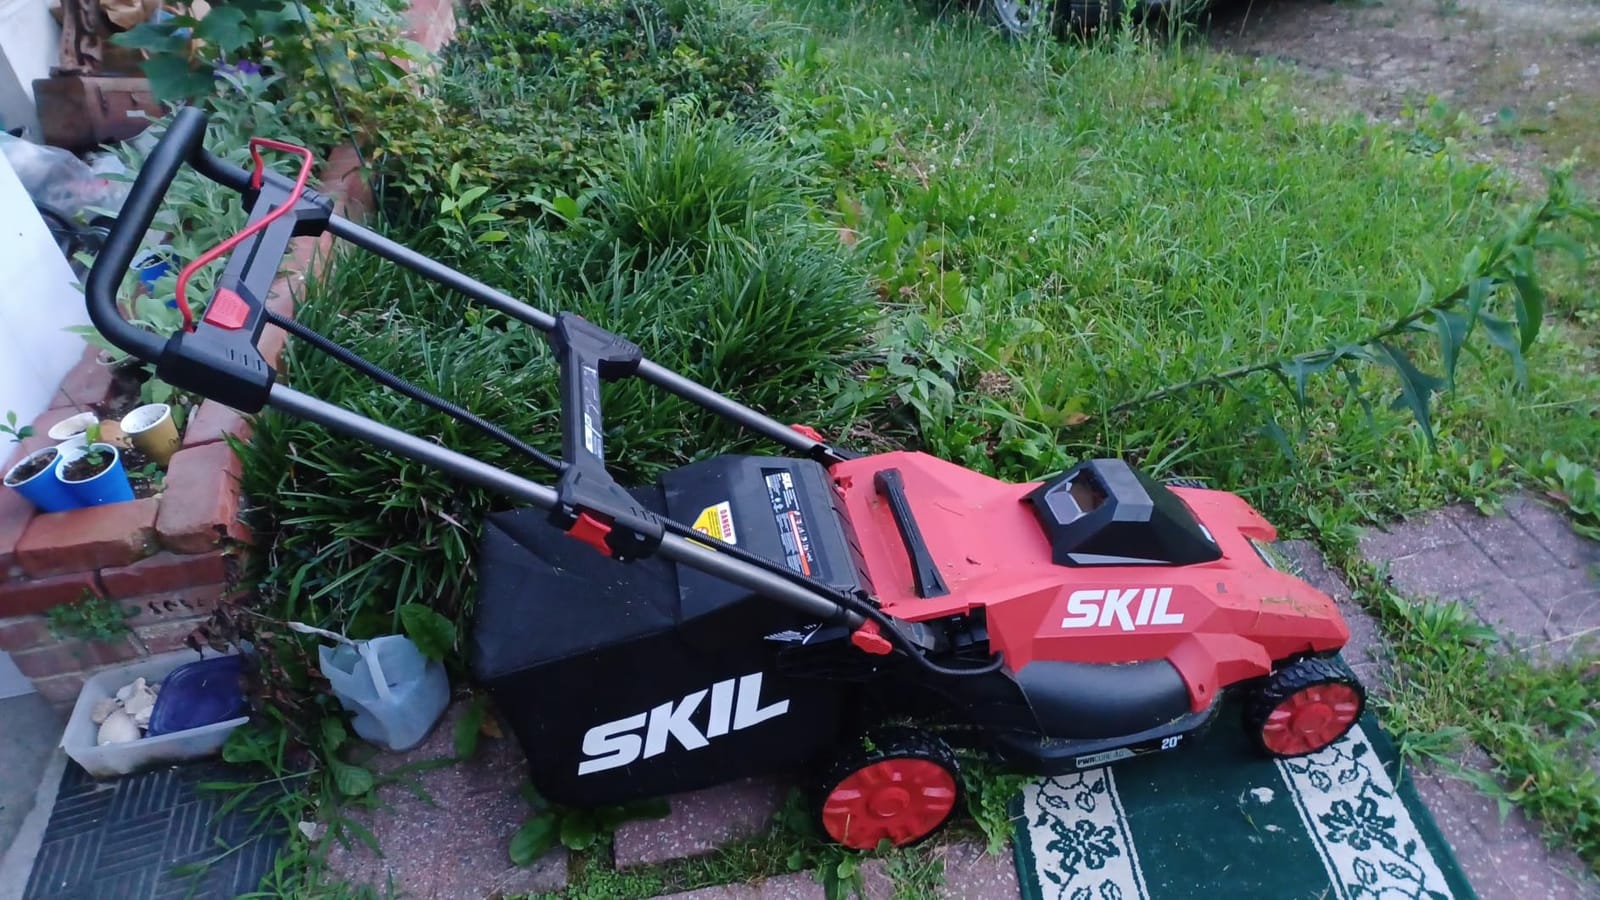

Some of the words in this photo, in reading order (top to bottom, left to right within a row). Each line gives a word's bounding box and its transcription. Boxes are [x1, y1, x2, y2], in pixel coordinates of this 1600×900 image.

[1061, 587, 1184, 631] SKIL
[578, 671, 790, 776] SKIL
[1161, 735, 1183, 750] 20"
